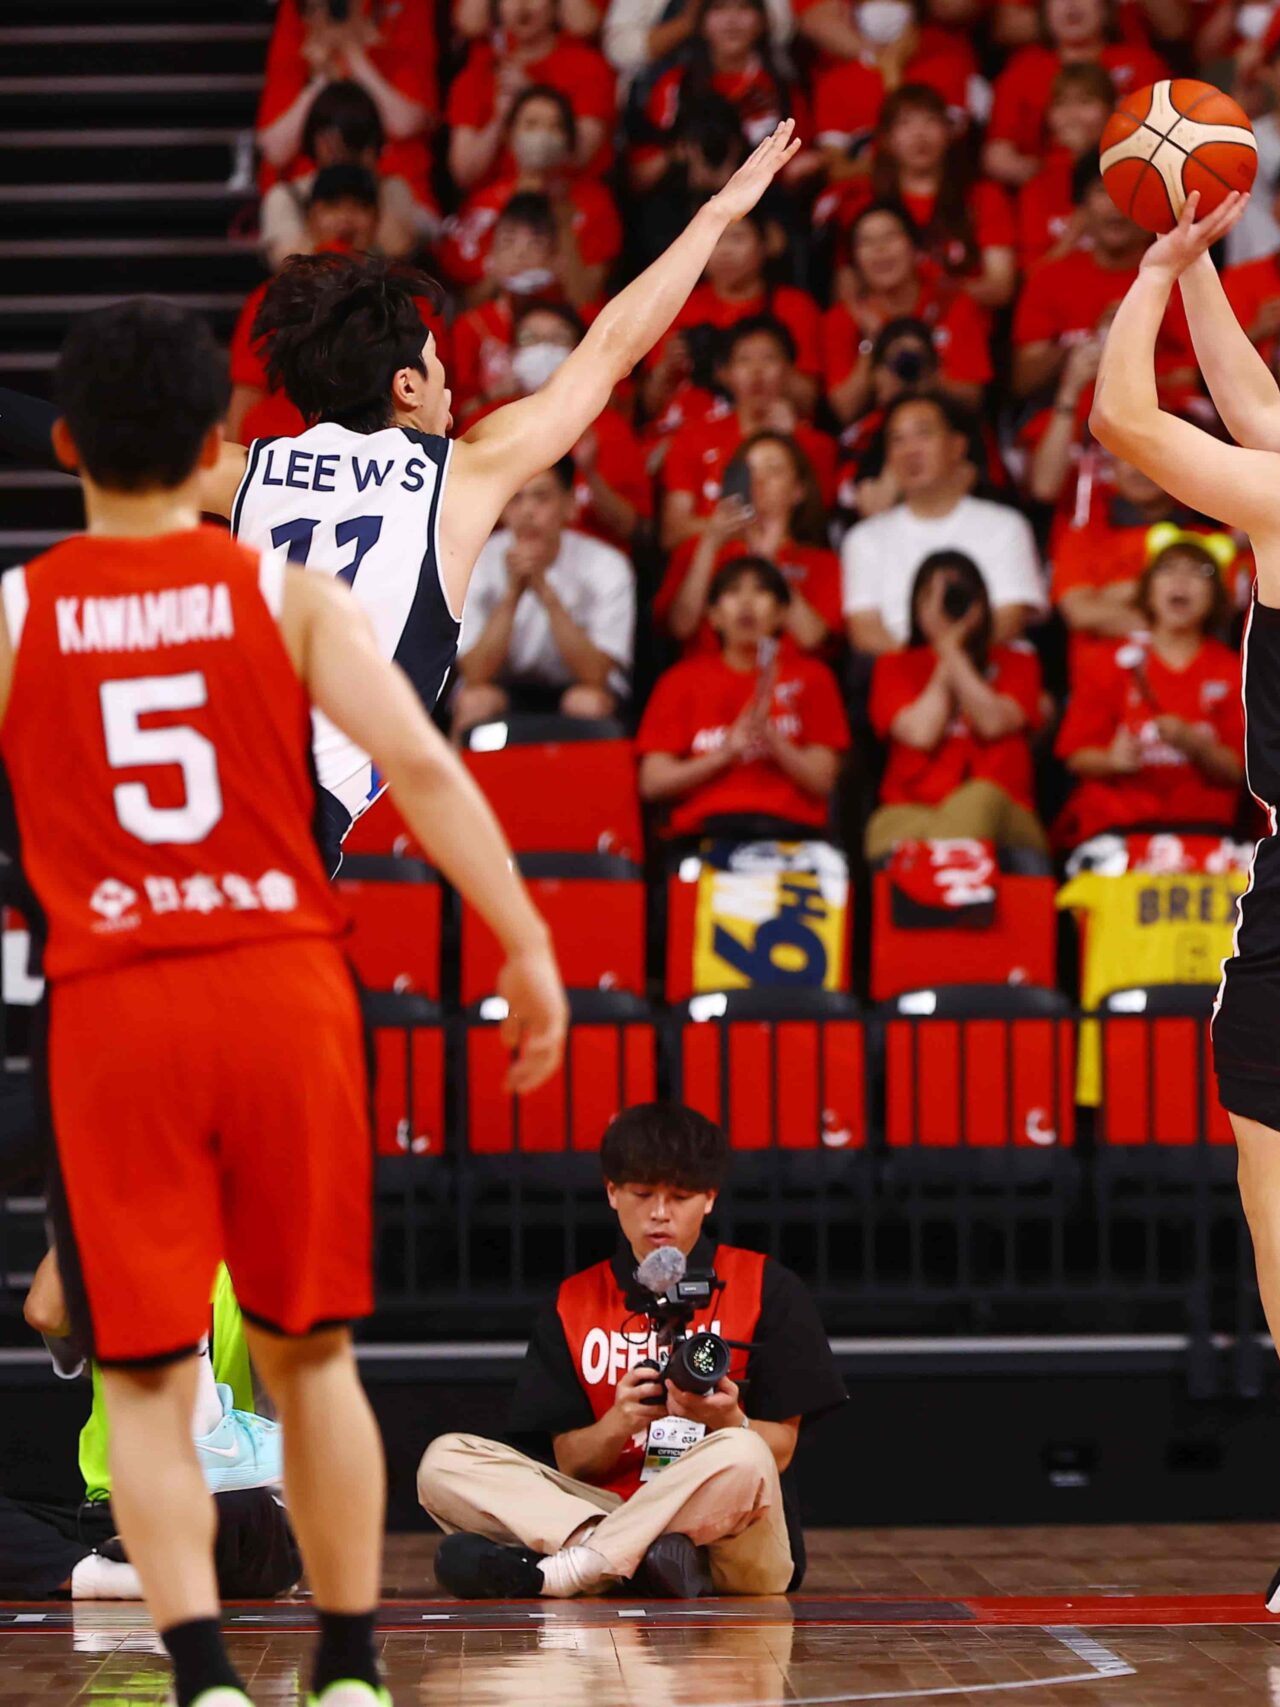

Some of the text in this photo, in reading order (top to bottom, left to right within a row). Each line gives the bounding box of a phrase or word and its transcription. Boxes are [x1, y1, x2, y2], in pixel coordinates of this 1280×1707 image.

[263, 449, 427, 493] LEE W S
[55, 582, 235, 655] KAWAMURA
[100, 671, 224, 844] 5
